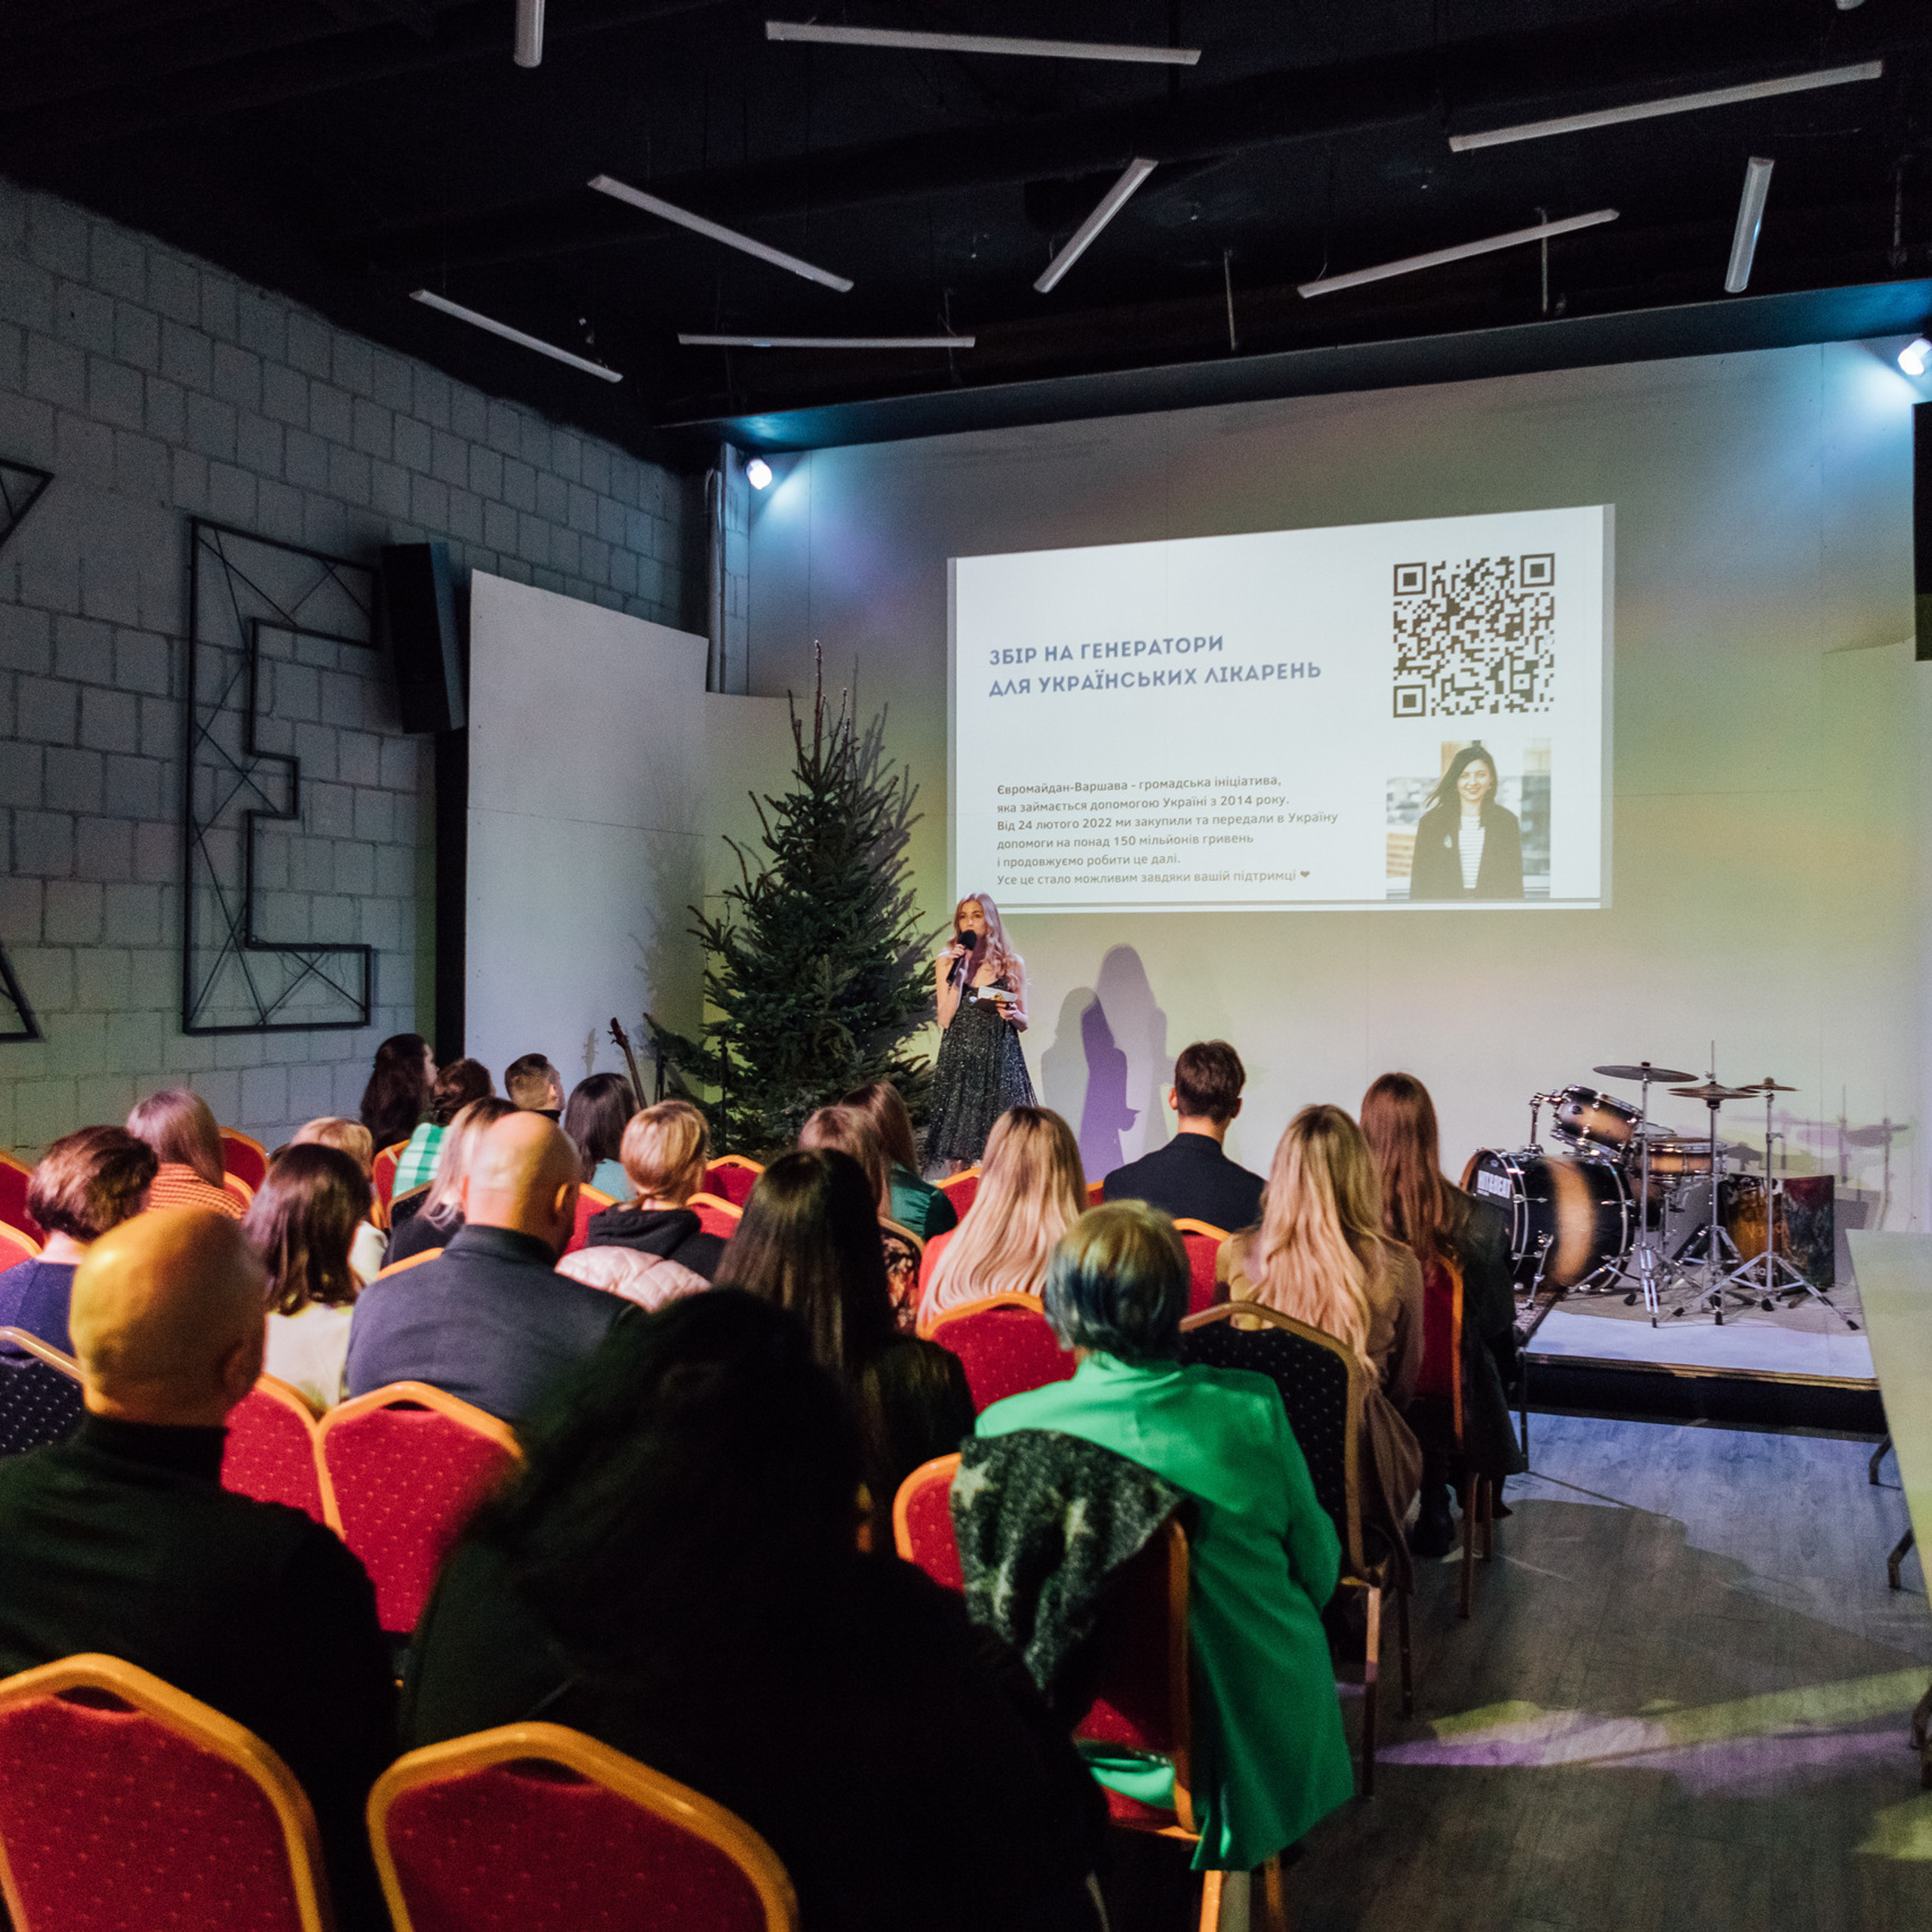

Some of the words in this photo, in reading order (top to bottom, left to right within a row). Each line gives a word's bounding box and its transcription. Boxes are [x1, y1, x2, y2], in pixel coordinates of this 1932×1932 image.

[989, 647, 1038, 666] ЗБІР
[1044, 645, 1074, 663] НА
[1081, 635, 1223, 660] ГЕНЕРАТОРИ
[988, 678, 1031, 698] ДЛЯ
[1038, 667, 1198, 694] УКРАЇНСЬКИХ
[1204, 661, 1321, 685] ЛІКАРЕНЬ
[996, 781, 1128, 796] Євромайдан-Варшава
[1139, 779, 1211, 792] громадська
[1214, 776, 1281, 788] ініціатива,
[997, 804, 1017, 813] яка
[1020, 801, 1088, 813] займається
[1090, 799, 1160, 812] допомогою
[1163, 797, 1207, 810] Україні
[1211, 798, 1217, 807] з
[1220, 795, 1253, 806] 2014
[1256, 796, 1289, 807] року.
[997, 820, 1016, 832] Від
[1018, 820, 1033, 830] 24
[1035, 820, 1080, 830] лютого
[1082, 817, 1112, 829] 2022
[1115, 819, 1131, 827] ми
[1135, 817, 1192, 829] закупили
[1196, 817, 1209, 825] та
[1212, 815, 1274, 826] передали
[1277, 815, 1284, 823] в
[1288, 813, 1338, 825] Україну
[996, 840, 1054, 851] допомоги
[1056, 839, 1071, 848] на
[1073, 838, 1110, 848] понад
[1114, 835, 1137, 846] 150
[1139, 834, 1200, 845] мільйонів
[1202, 835, 1254, 846] гривень
[997, 856, 1001, 867] і
[1003, 857, 1084, 869] продовжуємо
[1087, 854, 1131, 868] робити
[1134, 856, 1148, 866] це
[1151, 853, 1180, 866] далі.
[997, 875, 1017, 885] Усе
[1020, 876, 1035, 886] це
[1037, 875, 1072, 884] стало
[1074, 875, 1138, 884] можливим
[1141, 874, 1191, 884] завдяки
[1194, 870, 1230, 881] вашій
[1233, 869, 1296, 883] підтримці
